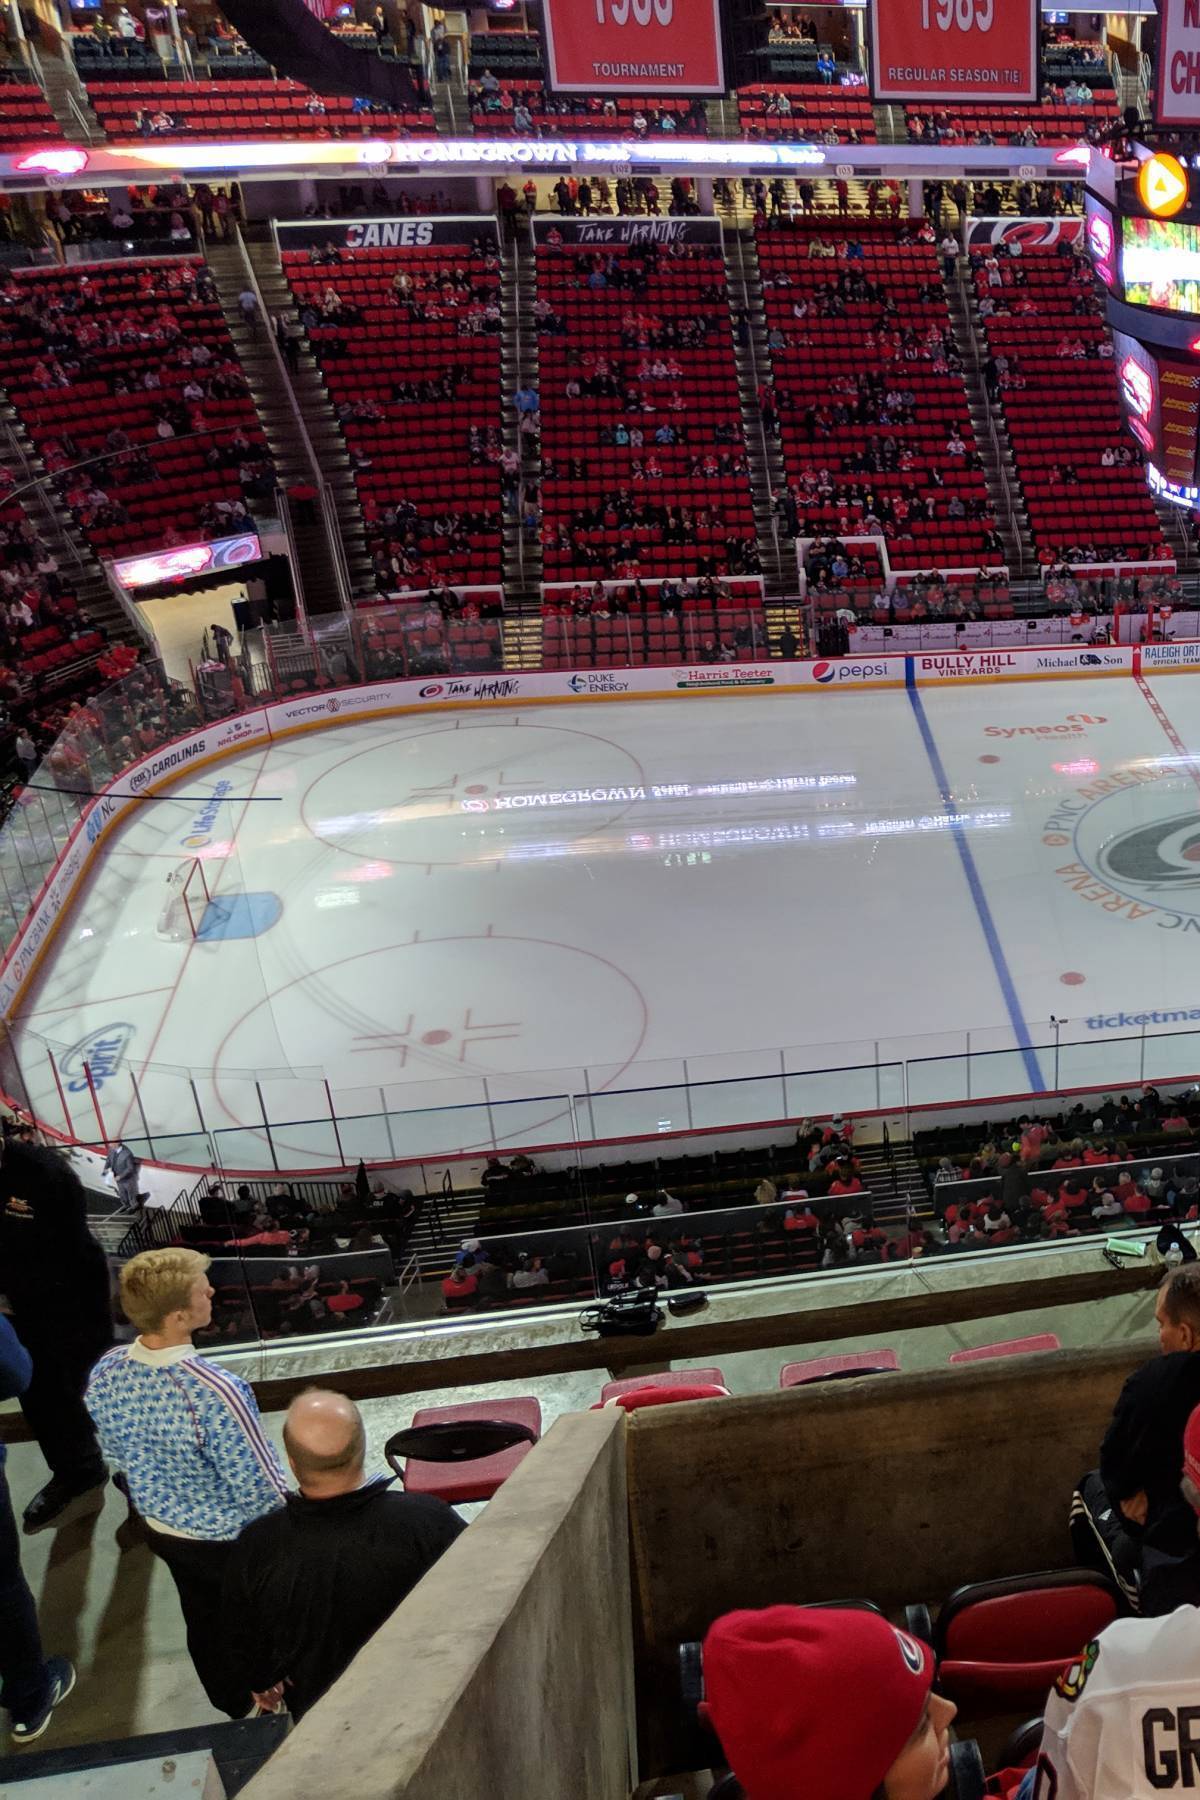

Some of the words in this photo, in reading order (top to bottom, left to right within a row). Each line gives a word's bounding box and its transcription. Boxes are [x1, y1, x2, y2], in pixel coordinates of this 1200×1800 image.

[593, 63, 685, 76] TOURNAMENT
[889, 67, 946, 81] REGULAR
[950, 69, 998, 82] SEASON
[346, 222, 433, 247] CANES
[576, 224, 614, 241] TAKE
[1145, 646, 1181, 659] RALEIGH
[921, 658, 975, 669] BULLY
[980, 655, 1016, 667] HILL
[1037, 657, 1078, 668] Michael
[1103, 655, 1123, 665] Son
[688, 670, 729, 680] Harris
[732, 668, 773, 678] Teeter
[838, 662, 888, 679] pepsi
[938, 666, 1001, 677] VINEYARDS
[588, 673, 615, 683] DUKE
[444, 682, 473, 699] TAKE
[589, 682, 630, 693] ENERGY
[285, 704, 325, 718] VECTOR
[983, 725, 1084, 738] Syneos
[151, 739, 206, 777] CAROLINAS
[1076, 766, 1178, 801] ARENA
[101, 797, 116, 819] NC
